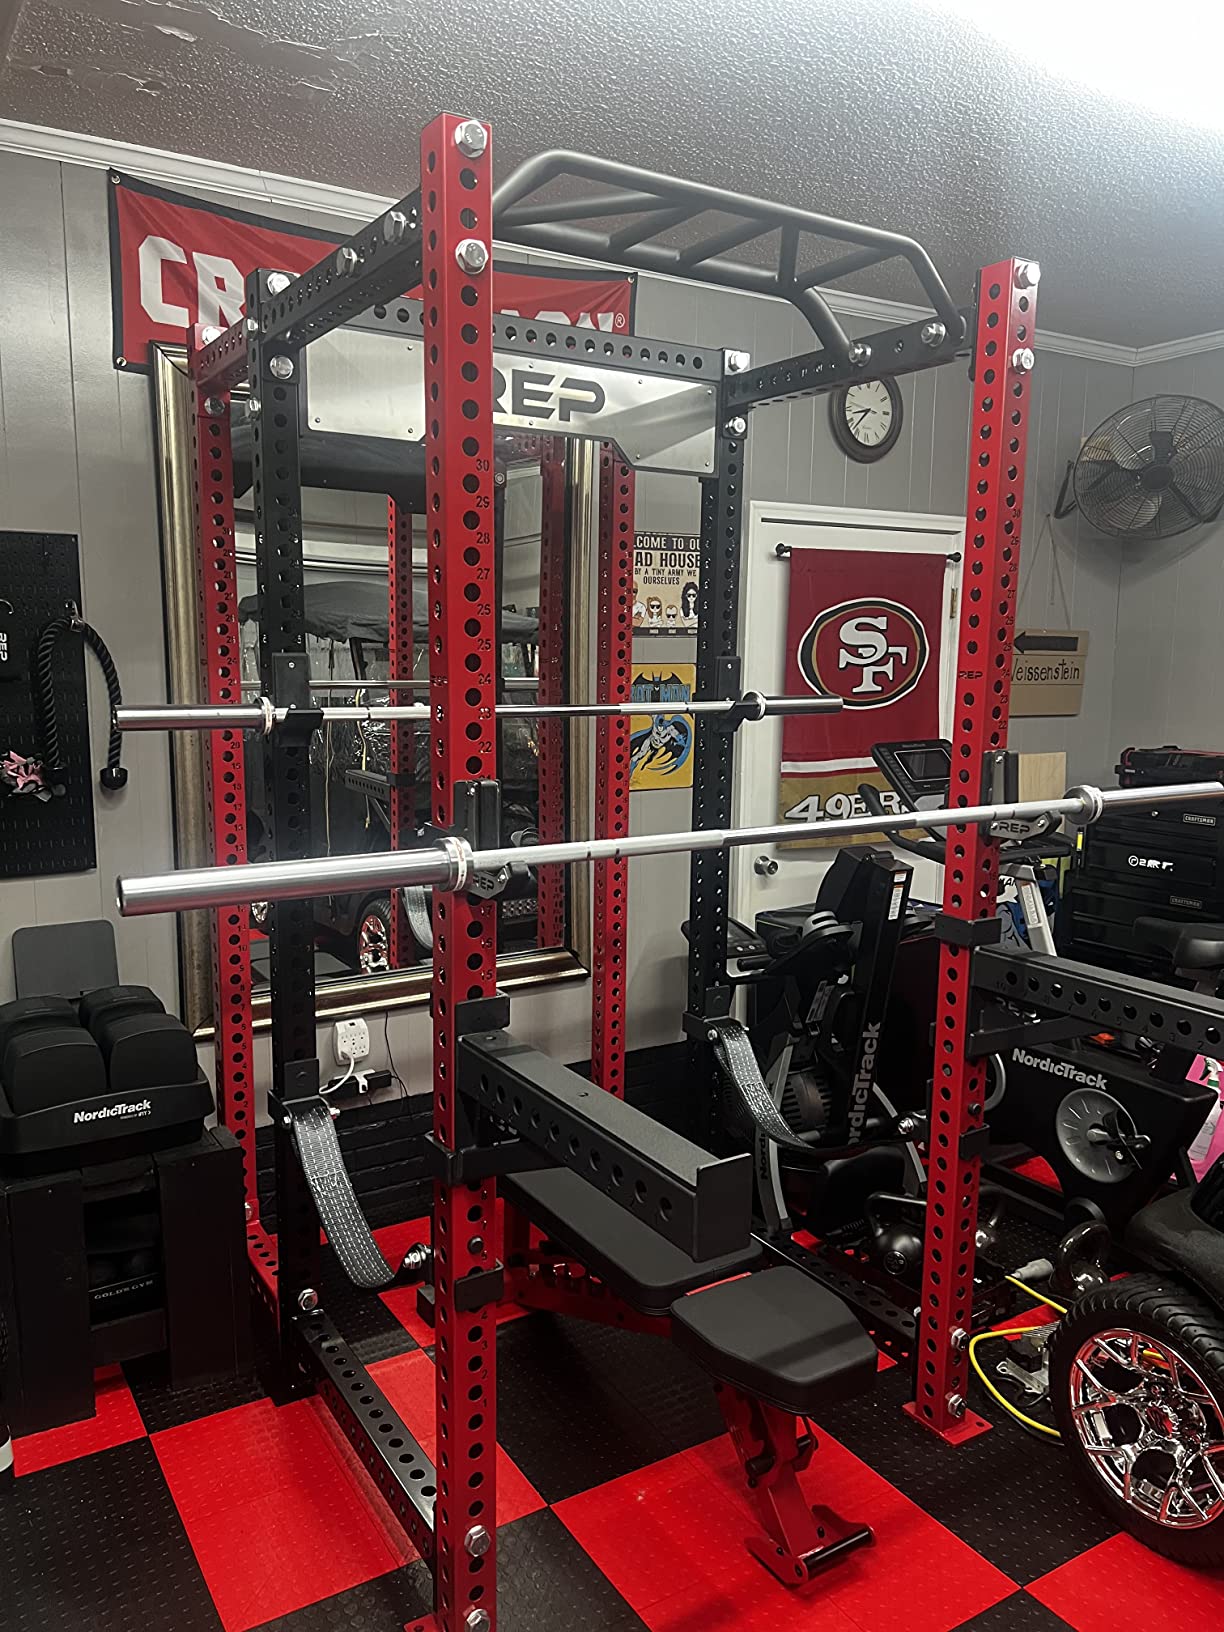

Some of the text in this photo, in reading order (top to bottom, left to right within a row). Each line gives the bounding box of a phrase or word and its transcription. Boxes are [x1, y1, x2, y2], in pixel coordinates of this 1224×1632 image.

[476, 459, 490, 472] 30
[476, 532, 491, 545] 28
[634, 535, 700, 550] COME TO OU
[634, 551, 700, 569] AD HOUSE
[476, 568, 491, 580] 27
[634, 567, 697, 577] BY A TINY ARMY WE
[643, 575, 681, 586] OURSELVES
[0, 632, 8, 662] REP
[477, 638, 492, 651] 25
[478, 673, 492, 685] 24
[958, 670, 984, 680] REP
[478, 741, 492, 754] 22
[1184, 815, 1214, 824] CRAFTSMAN
[999, 821, 1031, 834] REP
[1012, 1047, 1108, 1090] NordicTrack
[847, 1022, 881, 1144] rdicTrack
[73, 1099, 152, 1123] NordicTrack
[482, 1340, 489, 1350] 3
[481, 1370, 488, 1379] 2
